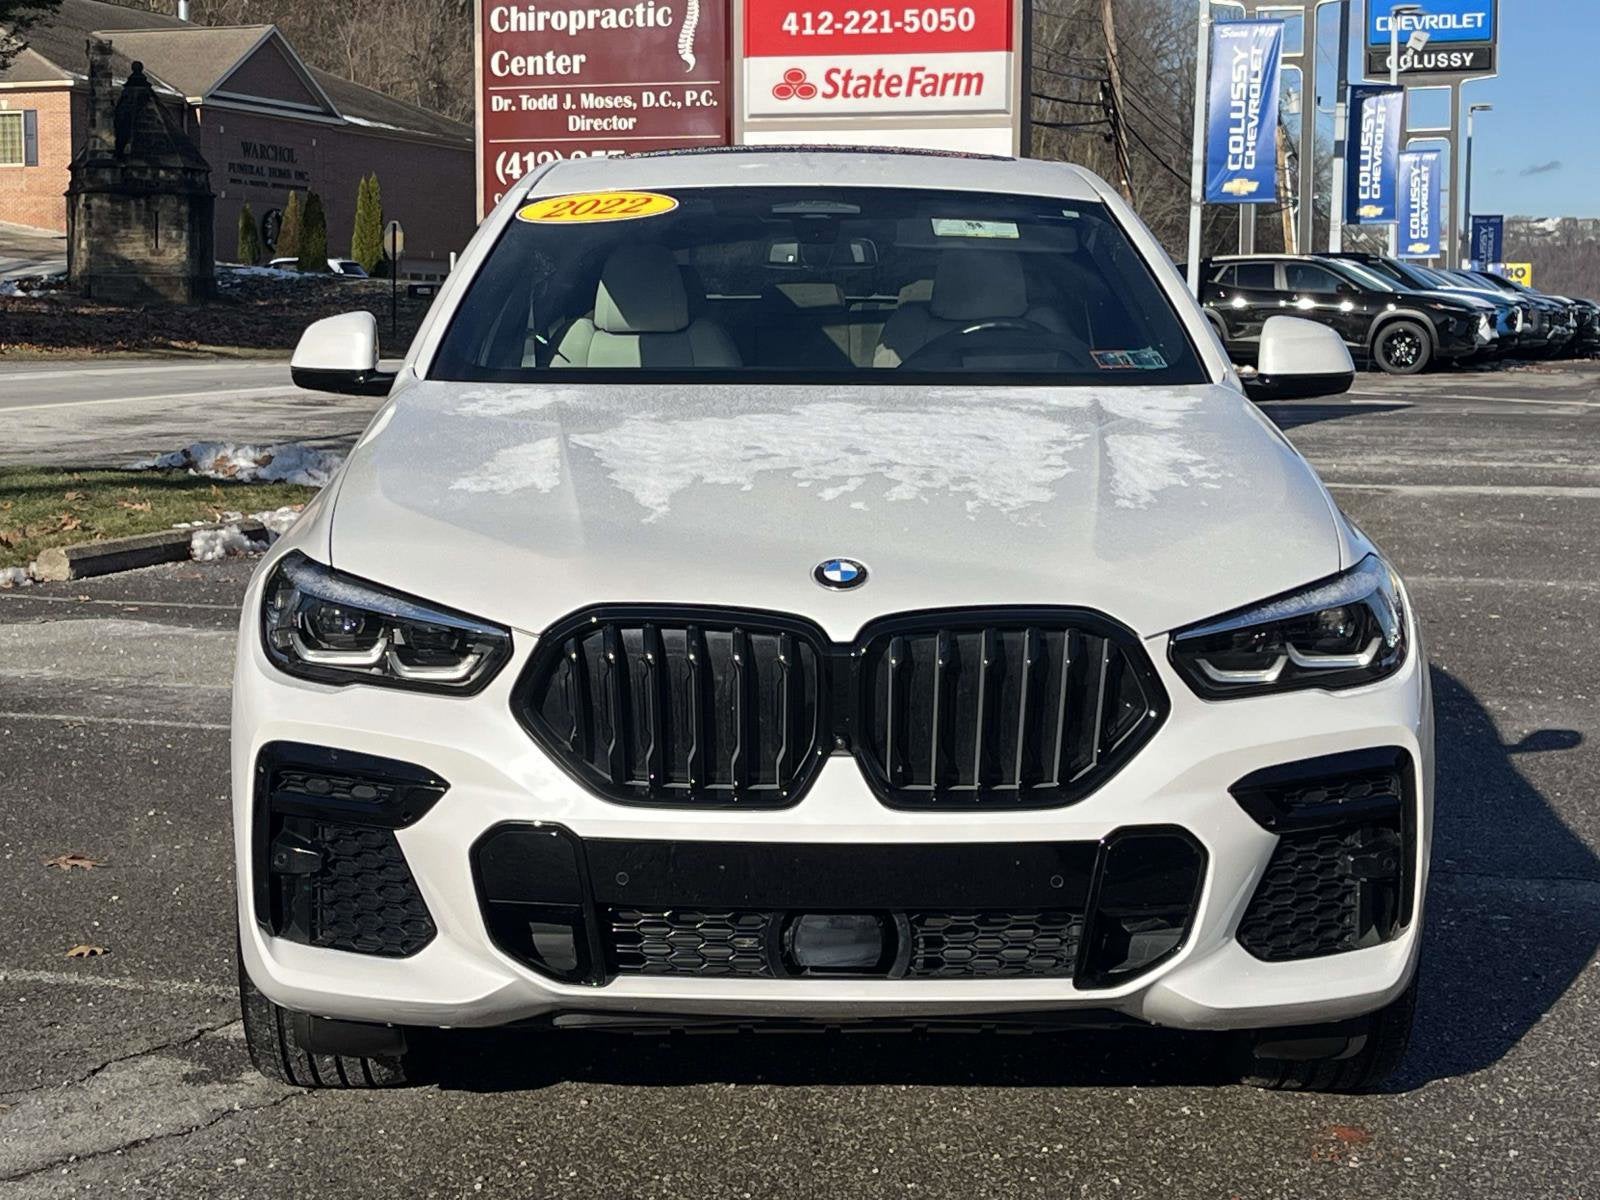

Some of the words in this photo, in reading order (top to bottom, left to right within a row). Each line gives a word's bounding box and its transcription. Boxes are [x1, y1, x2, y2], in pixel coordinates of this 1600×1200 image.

[490, 2, 673, 36] Chiropractic
[782, 7, 976, 36] 412-221-5050
[490, 50, 586, 77] Center
[491, 95, 516, 112] Dr.
[519, 94, 558, 111] Todd
[563, 93, 577, 110] J.
[580, 92, 638, 110] Moses,
[642, 91, 682, 108] D.C.,
[685, 90, 718, 107] P.C.
[1227, 45, 1248, 171] COLUSSY
[1244, 46, 1263, 170] CHEVROLET
[568, 115, 637, 132] Director
[240, 141, 298, 163] WARCHOL
[1358, 103, 1376, 200] COLUSSY
[1372, 105, 1387, 199] CHEVROLET
[542, 197, 653, 219] 2022
[1409, 166, 1421, 239] COLUSSY
[1420, 164, 1430, 238] CHEVROLET
